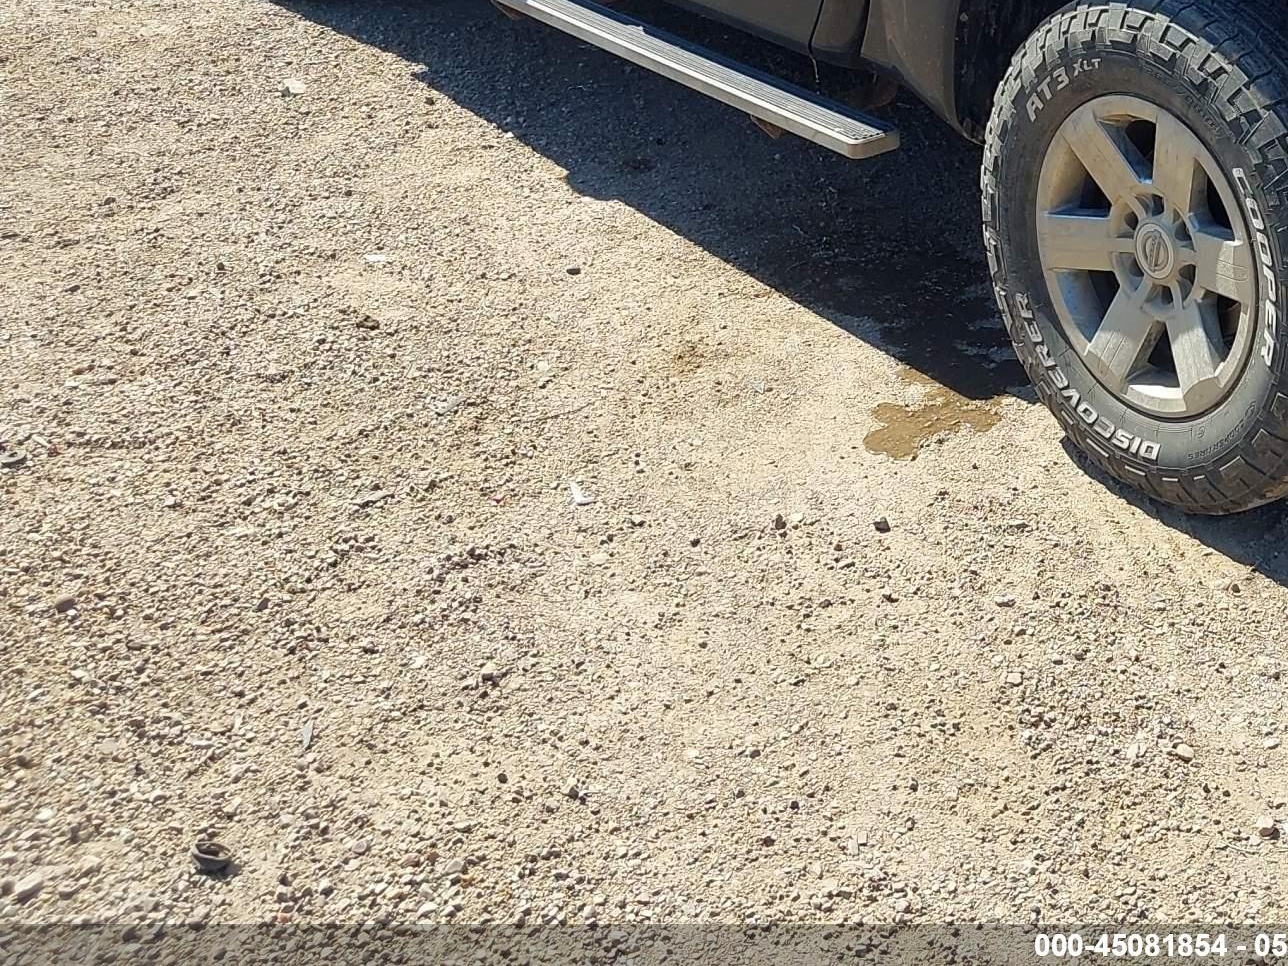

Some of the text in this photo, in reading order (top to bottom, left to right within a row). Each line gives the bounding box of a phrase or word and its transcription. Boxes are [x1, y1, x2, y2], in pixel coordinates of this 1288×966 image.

[1025, 57, 1102, 123] AT3 XLT
[1232, 167, 1277, 367] COOPER
[1015, 292, 1162, 461] DISCOVERER
